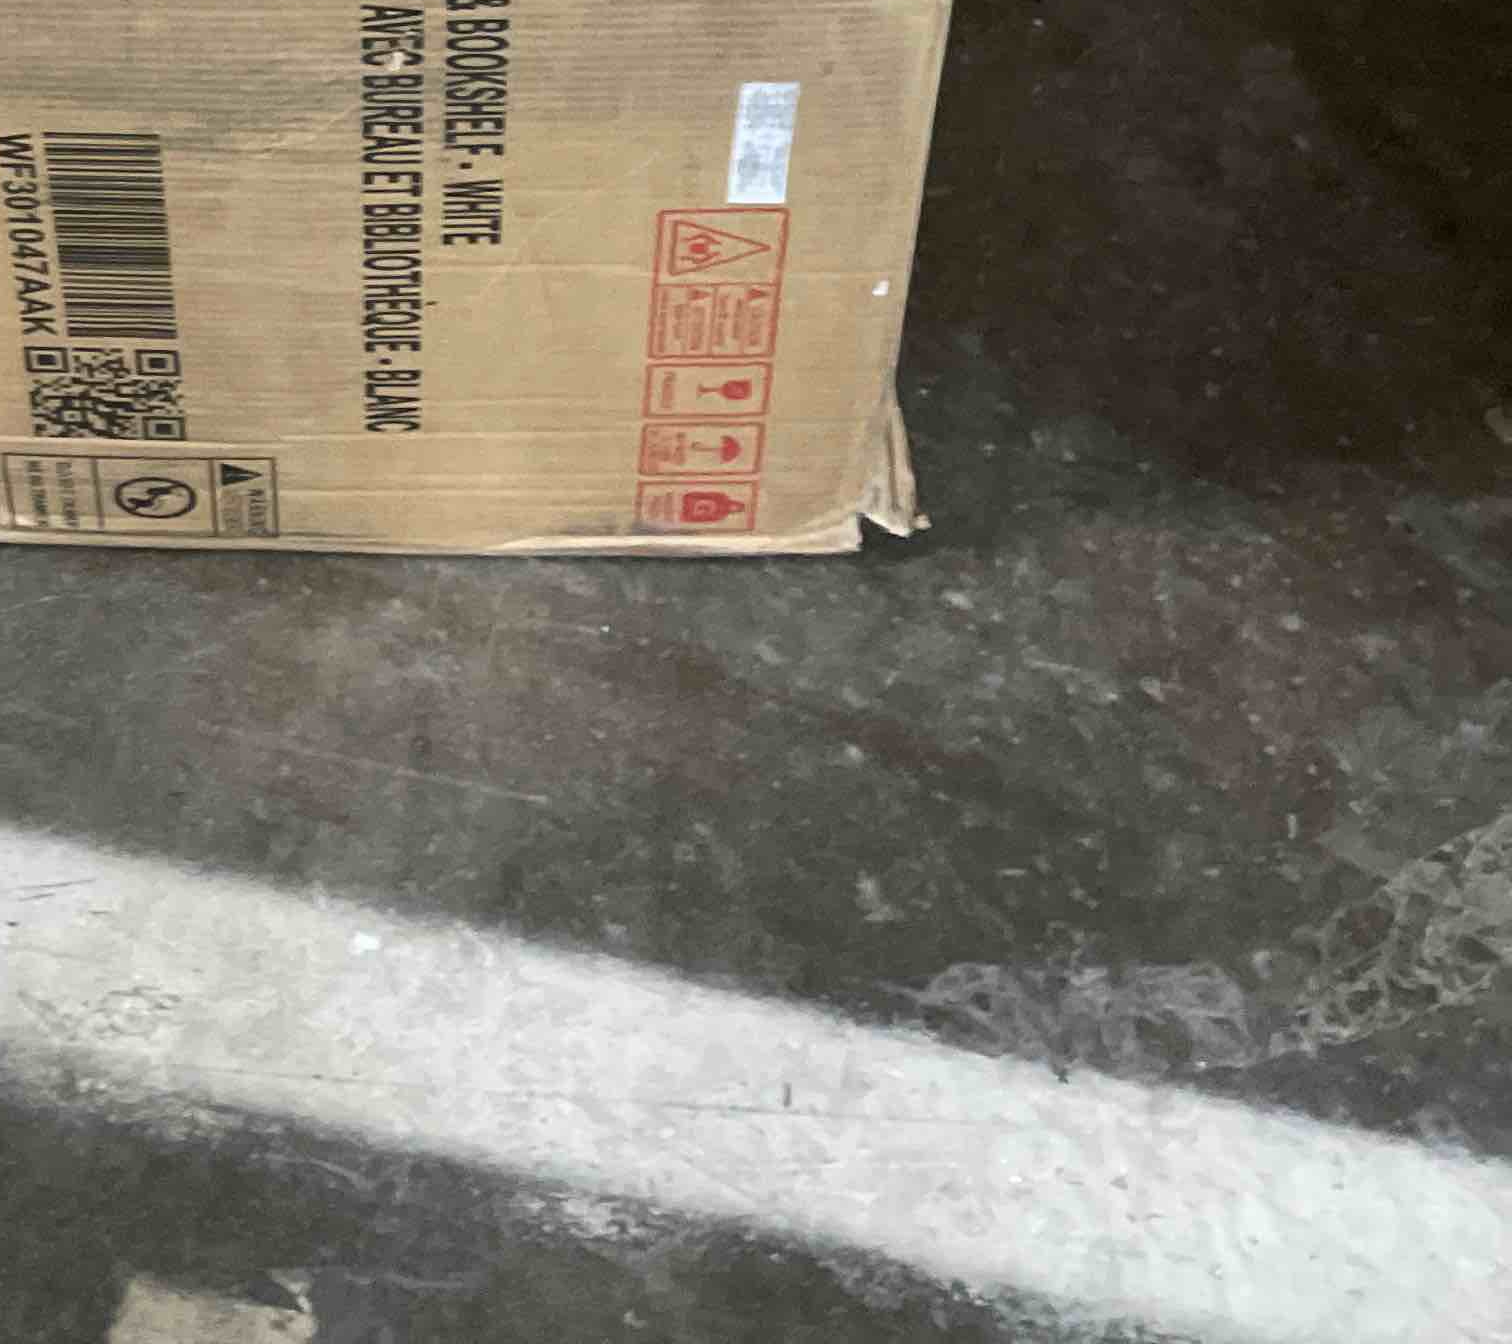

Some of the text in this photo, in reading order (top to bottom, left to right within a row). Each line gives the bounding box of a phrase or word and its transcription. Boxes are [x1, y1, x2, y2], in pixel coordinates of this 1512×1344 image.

[360, 5, 424, 67] AVEC
[361, 75, 422, 165] BUREAU
[442, 19, 506, 157] BOOKSHELF
[362, 171, 420, 196] ET
[440, 179, 502, 246] WHITE
[361, 203, 435, 353] BIBLIOTHÈQUE
[363, 369, 420, 433] BLANC
